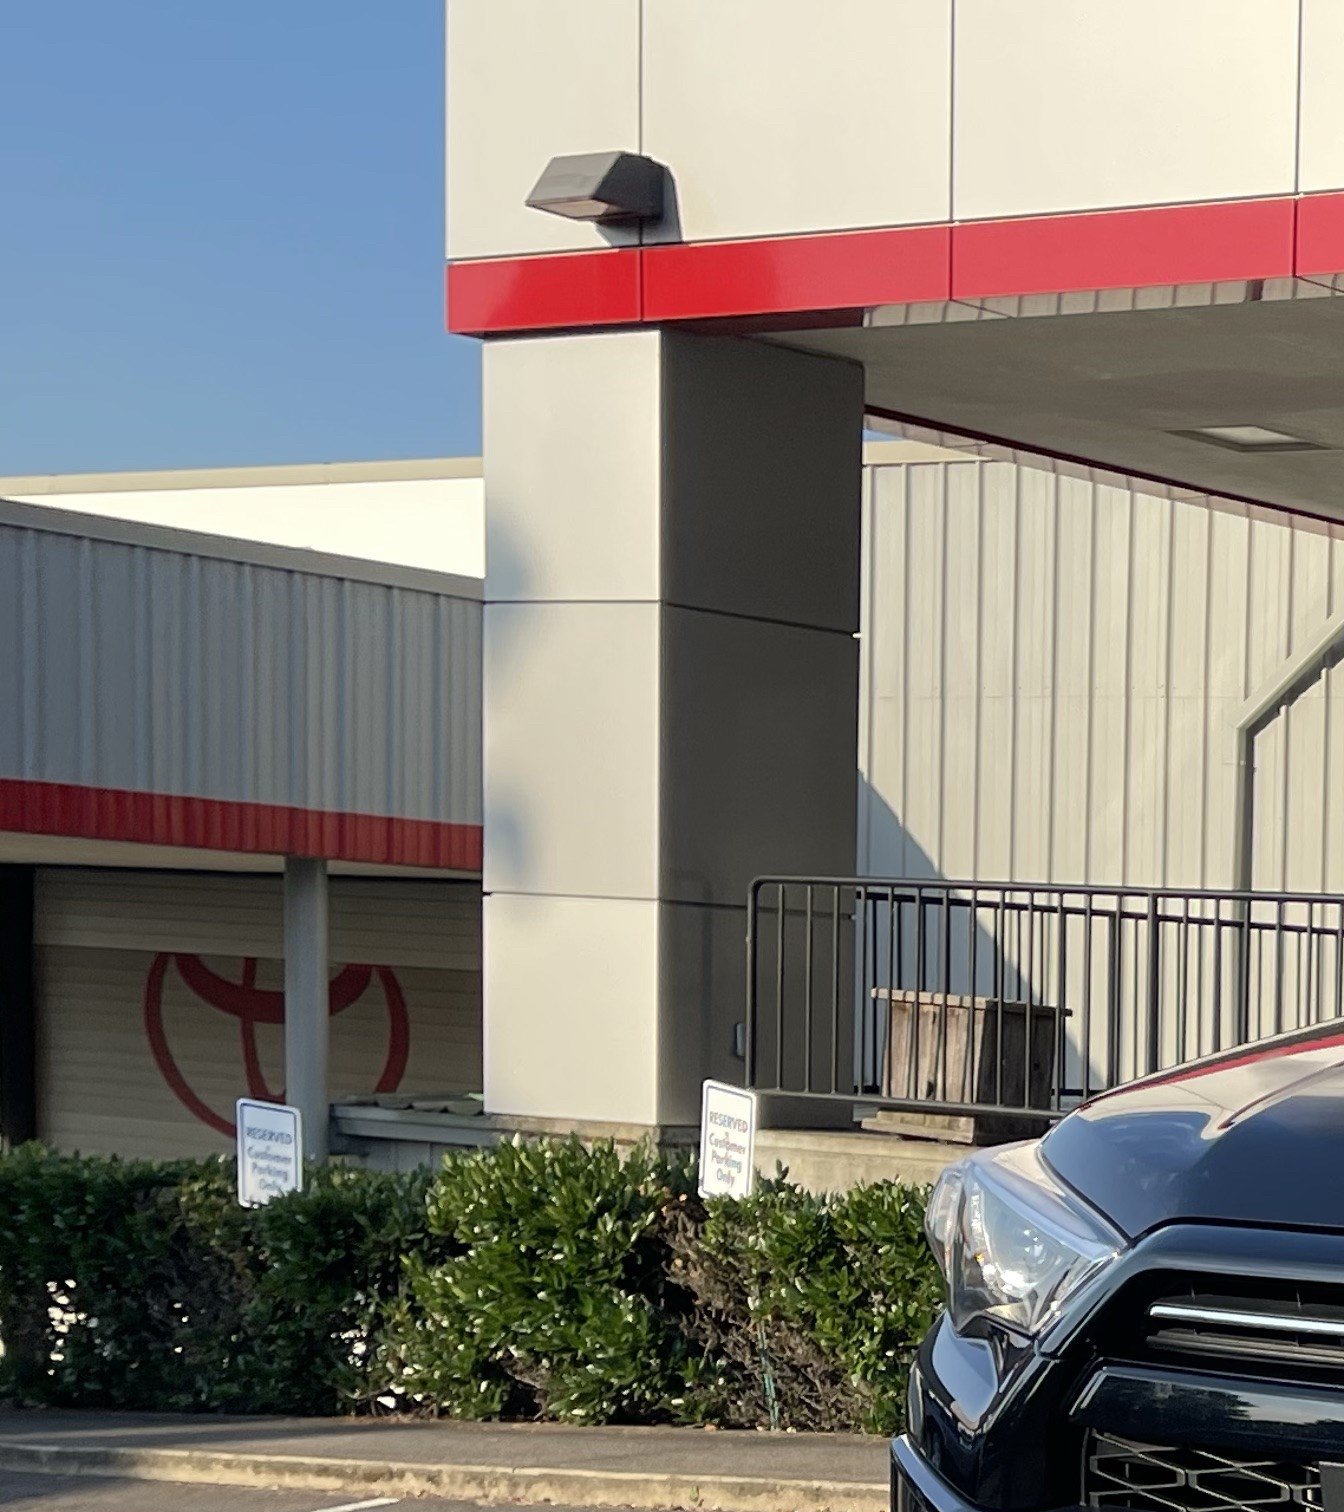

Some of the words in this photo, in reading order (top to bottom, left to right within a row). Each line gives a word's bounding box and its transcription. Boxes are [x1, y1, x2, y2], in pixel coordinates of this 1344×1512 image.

[709, 1111, 749, 1134] RESERVED
[246, 1127, 293, 1145] RESERVED
[709, 1132, 746, 1155] Customer
[711, 1149, 743, 1174] Parking
[716, 1168, 736, 1188] Only
